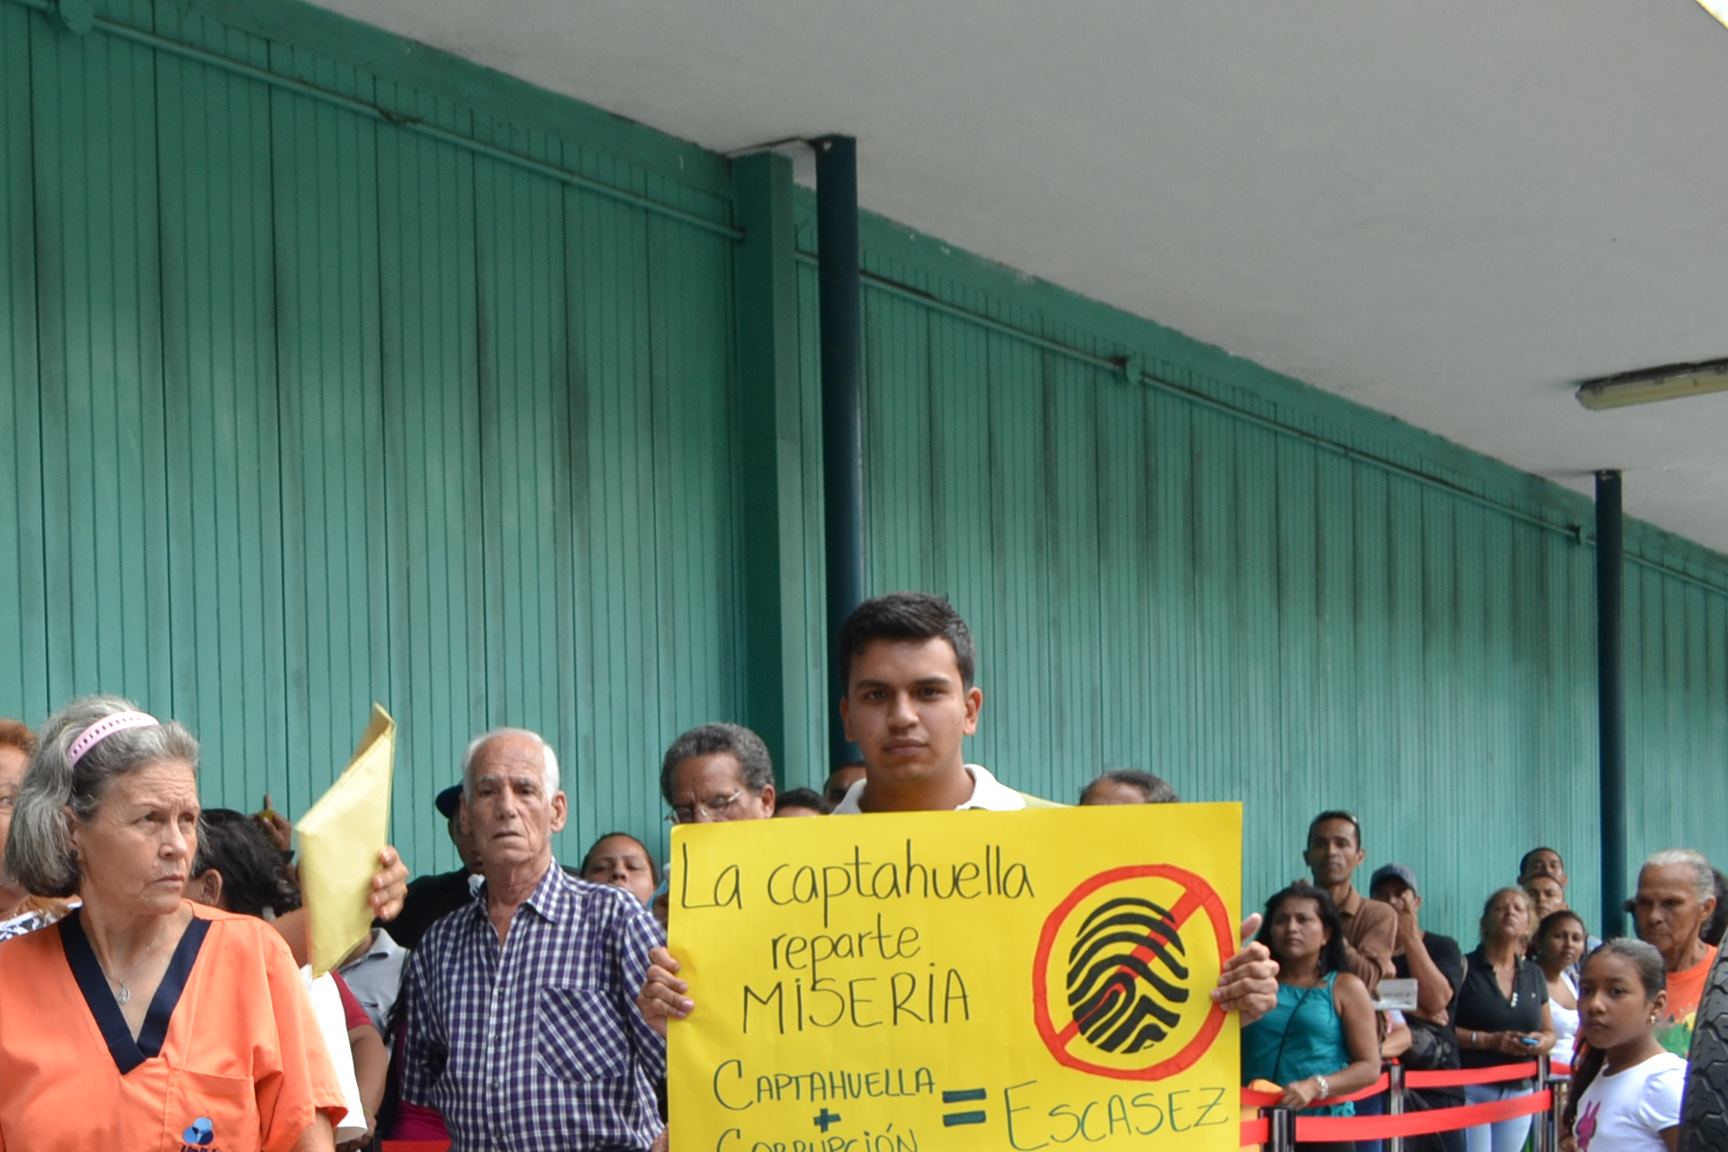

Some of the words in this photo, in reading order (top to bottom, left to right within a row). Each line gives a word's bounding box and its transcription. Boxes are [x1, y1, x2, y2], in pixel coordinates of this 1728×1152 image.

[681, 842, 743, 911] La
[766, 838, 1036, 929] captahuella
[770, 912, 922, 990] reparte
[712, 1058, 936, 1112] CAPTAHUELLA
[1002, 1079, 1230, 1152] ESCASEZ
